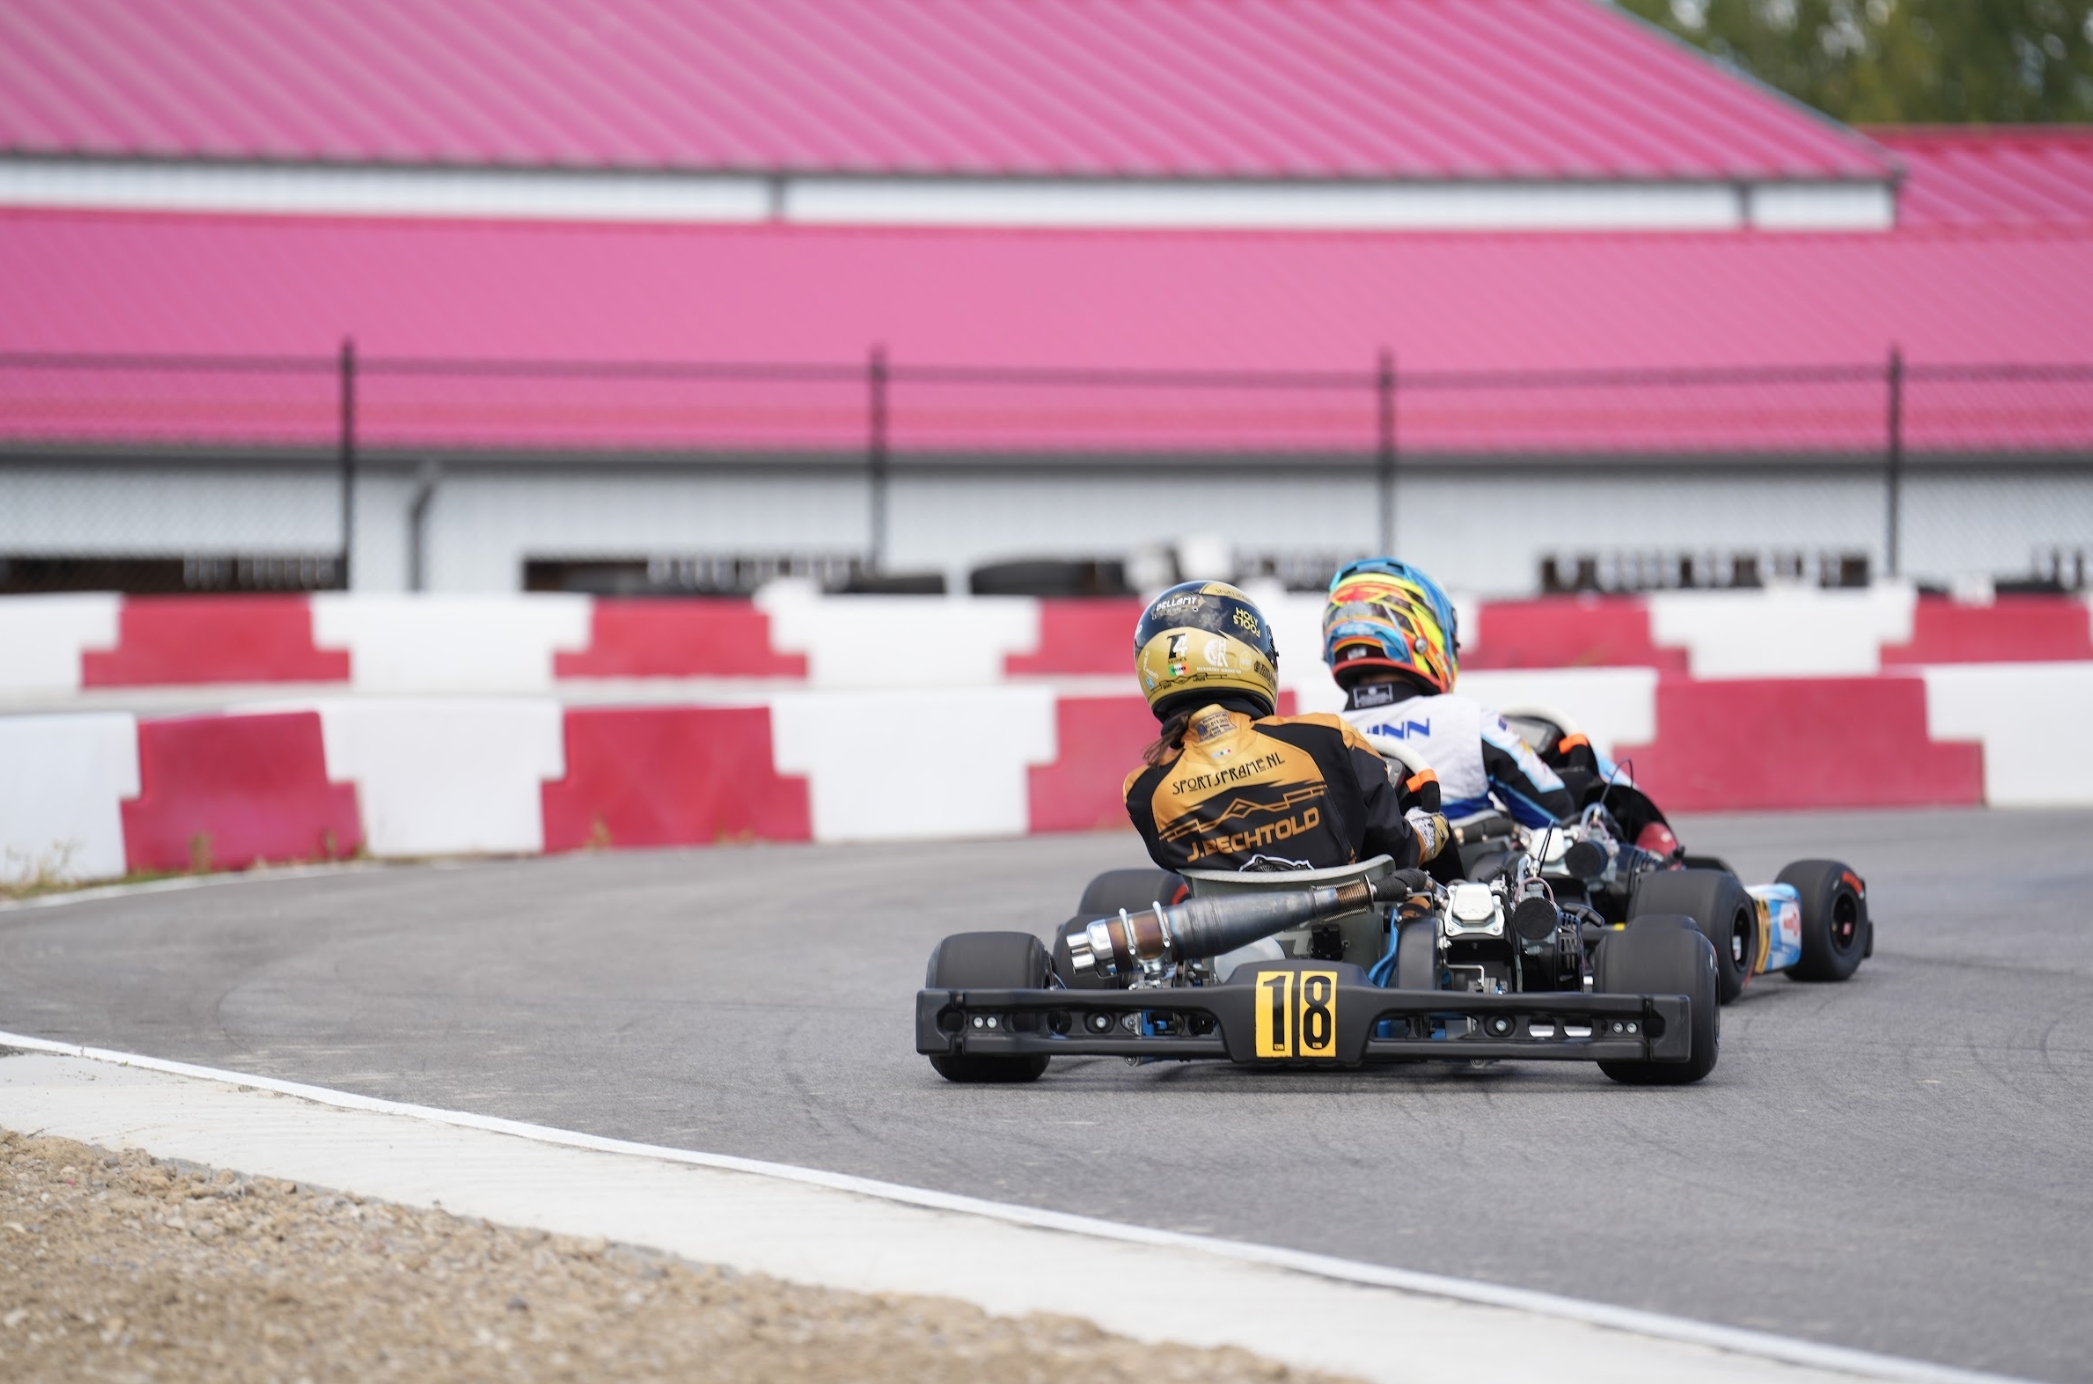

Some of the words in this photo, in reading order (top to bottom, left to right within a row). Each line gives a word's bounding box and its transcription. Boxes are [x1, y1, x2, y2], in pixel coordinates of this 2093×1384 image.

[1232, 614, 1261, 638] FOOLS
[1235, 606, 1259, 626] HOLY
[1262, 975, 1332, 1051] 18
